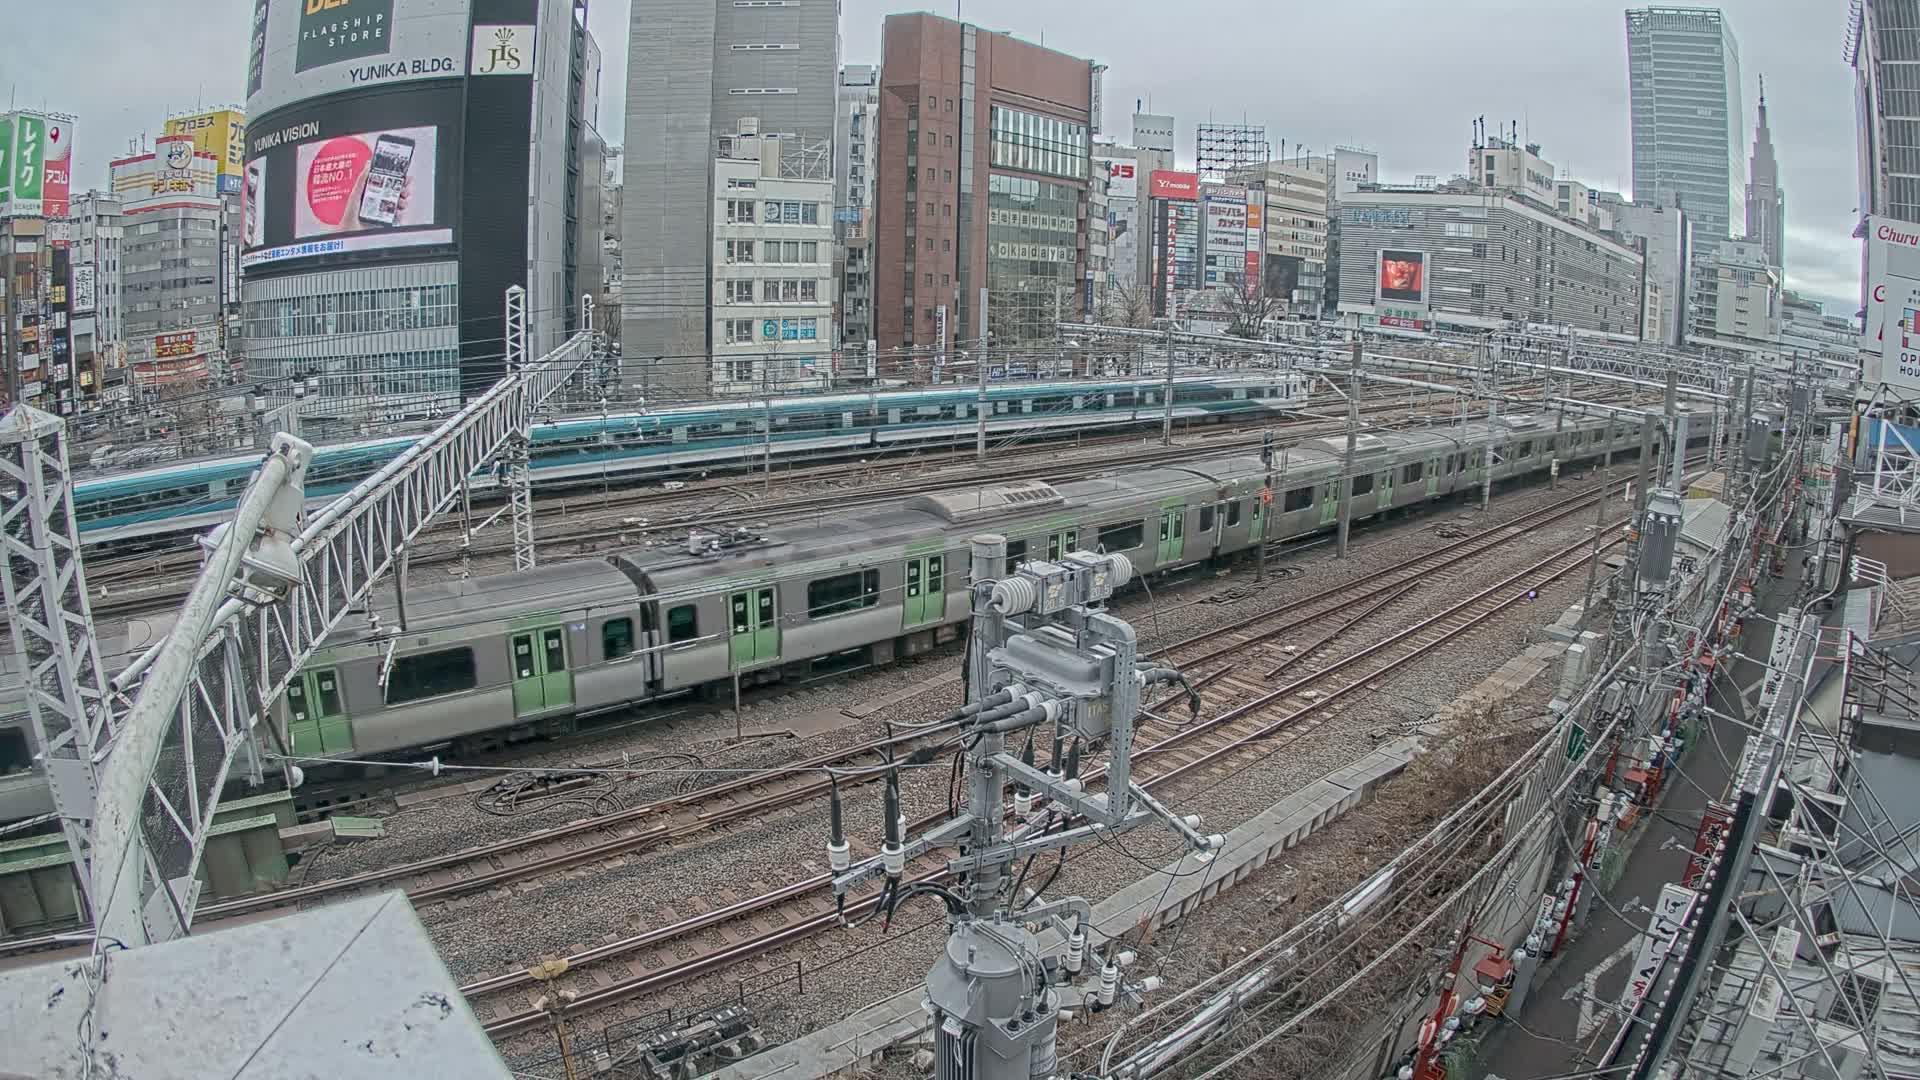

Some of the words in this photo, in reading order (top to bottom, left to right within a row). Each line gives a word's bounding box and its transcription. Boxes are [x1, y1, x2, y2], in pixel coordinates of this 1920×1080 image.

[303, 14, 383, 40] FLAGSHIP
[328, 28, 382, 47] STORE
[350, 61, 408, 83] YUNIKA
[411, 57, 456, 75] BLDG.
[176, 116, 215, 133] プロミス
[1134, 127, 1174, 137] TAKANO
[254, 135, 281, 153] YUNIKA
[282, 121, 320, 143] VISION
[21, 121, 37, 187] レイク
[45, 169, 68, 185] アコム
[1877, 225, 1920, 246] Churu
[1000, 245, 1066, 262] okadaya
[1900, 352, 1920, 365] OP
